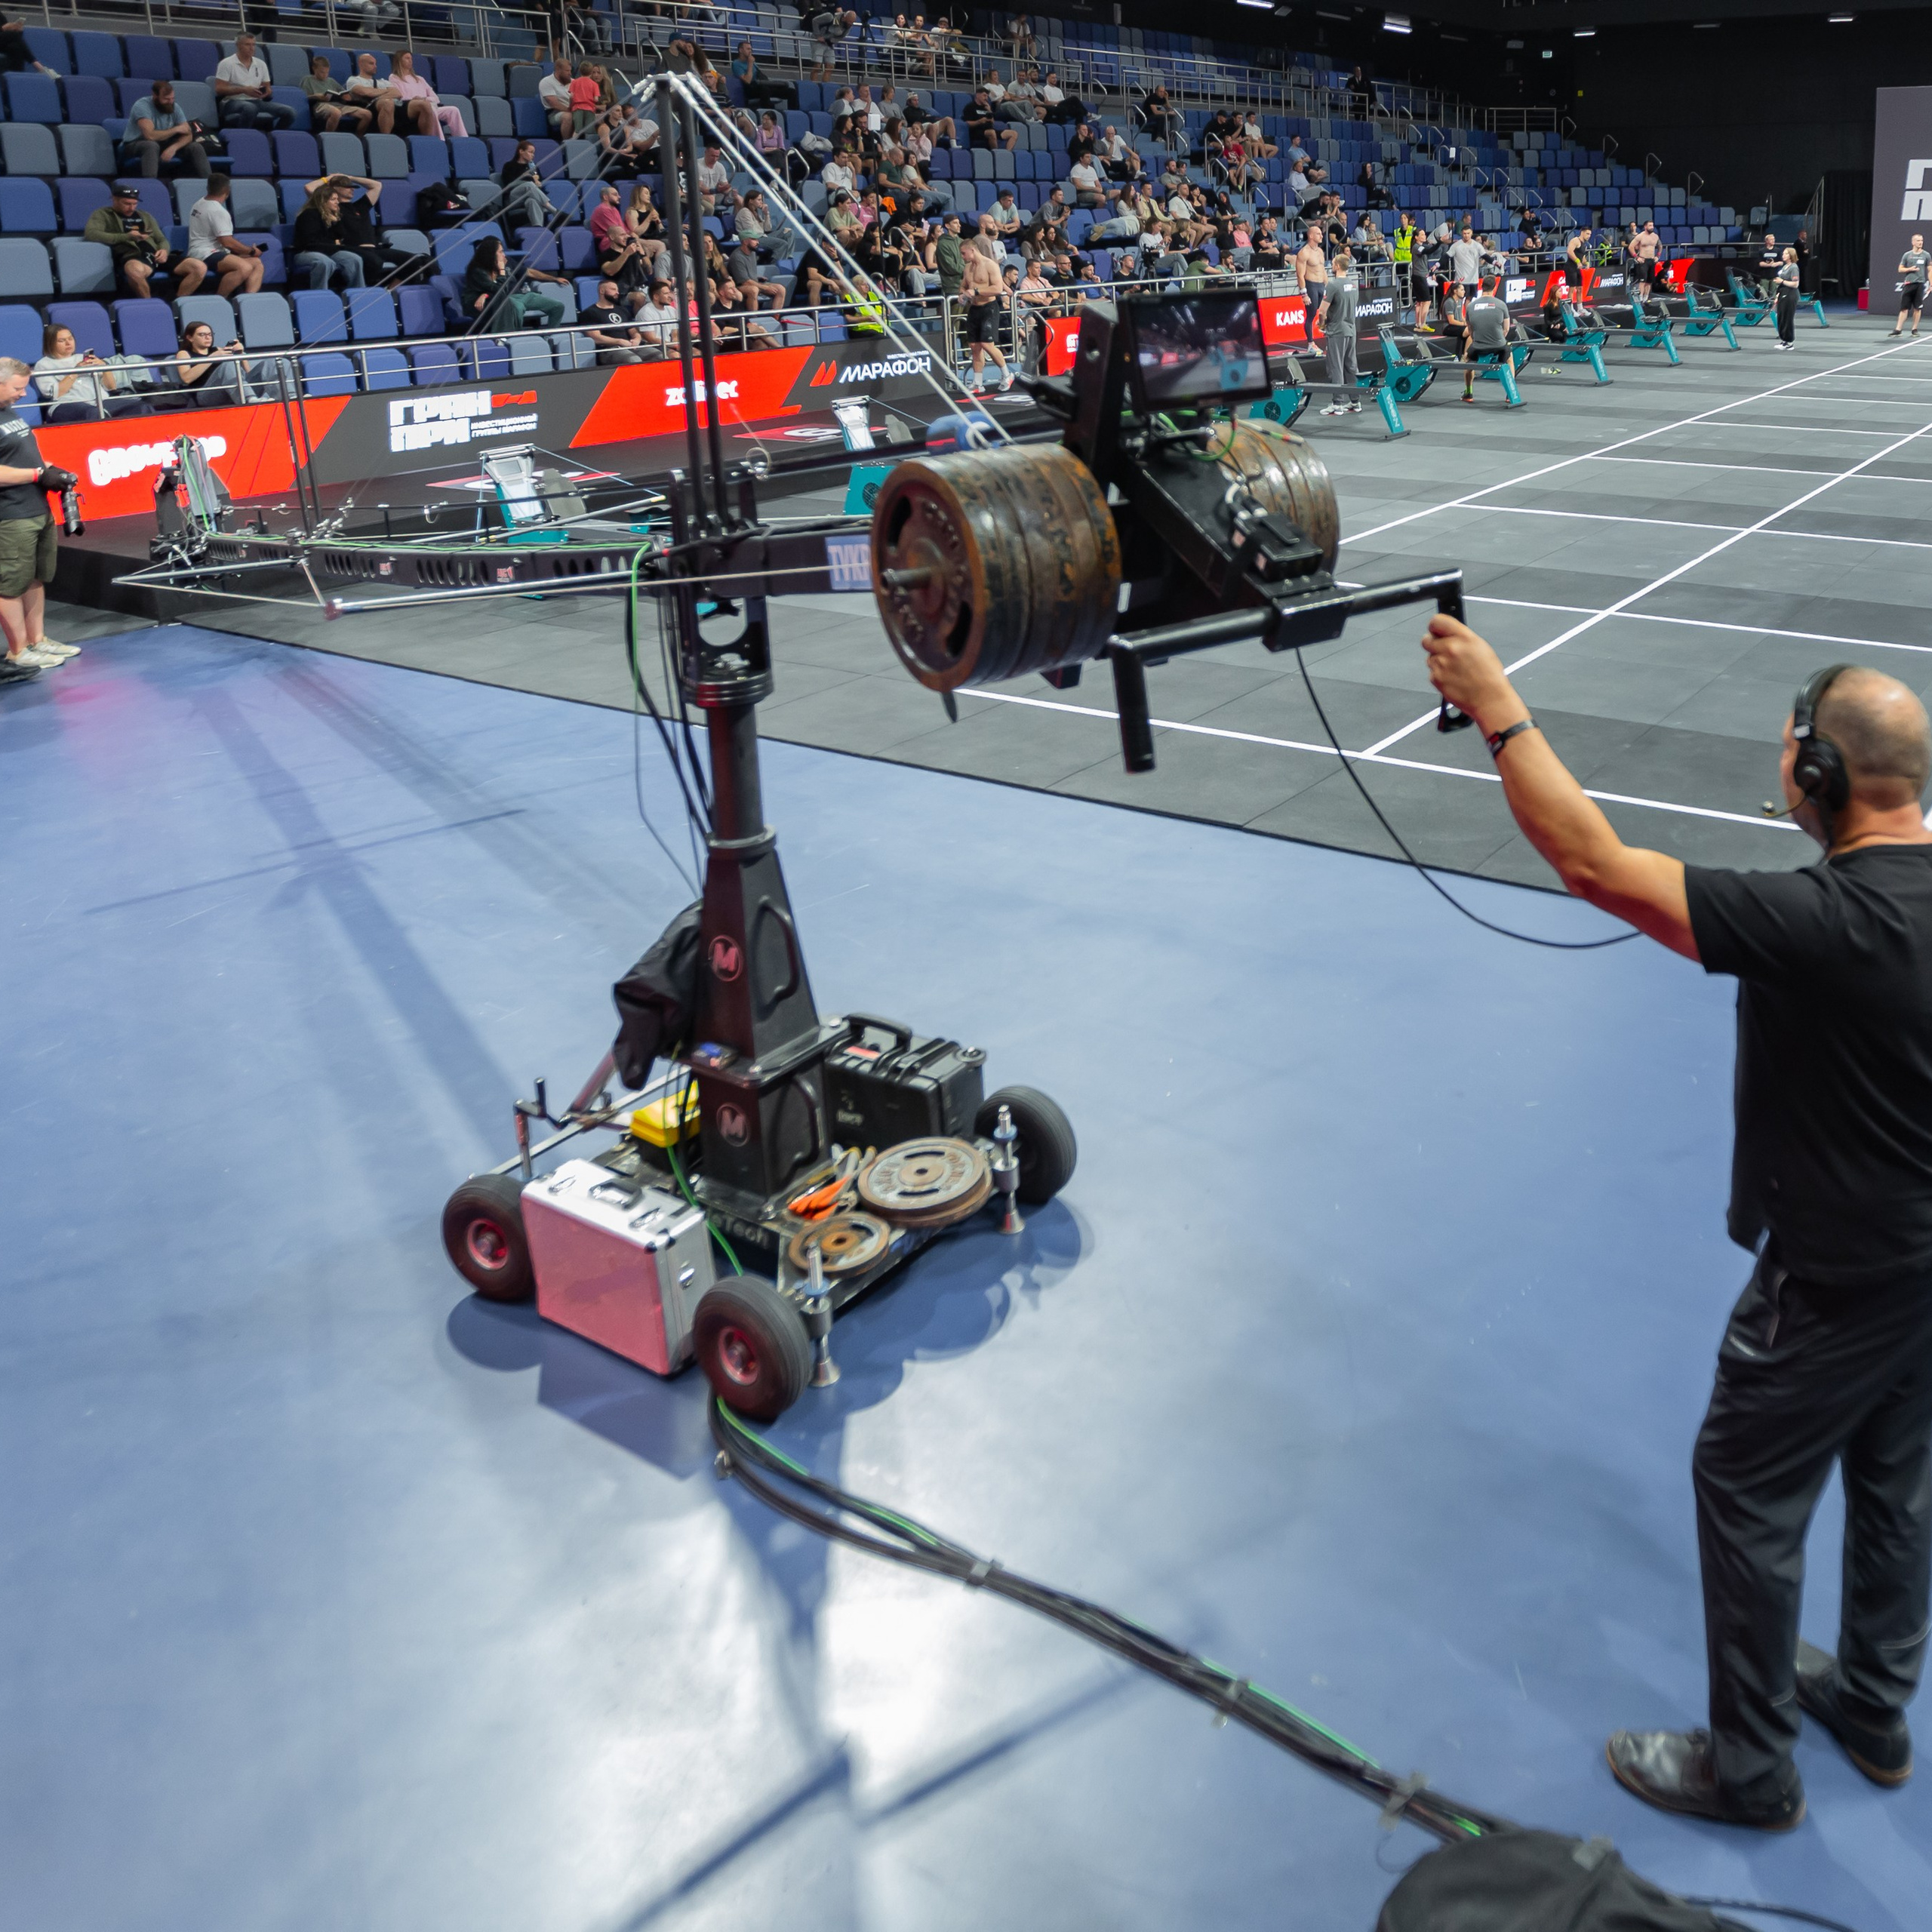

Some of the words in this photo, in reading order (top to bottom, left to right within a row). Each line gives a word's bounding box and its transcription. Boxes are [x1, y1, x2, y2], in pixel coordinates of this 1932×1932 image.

[839, 357, 931, 383] МАРАФОН
[389, 390, 492, 426] ГРАН
[390, 417, 471, 452] ПРИ
